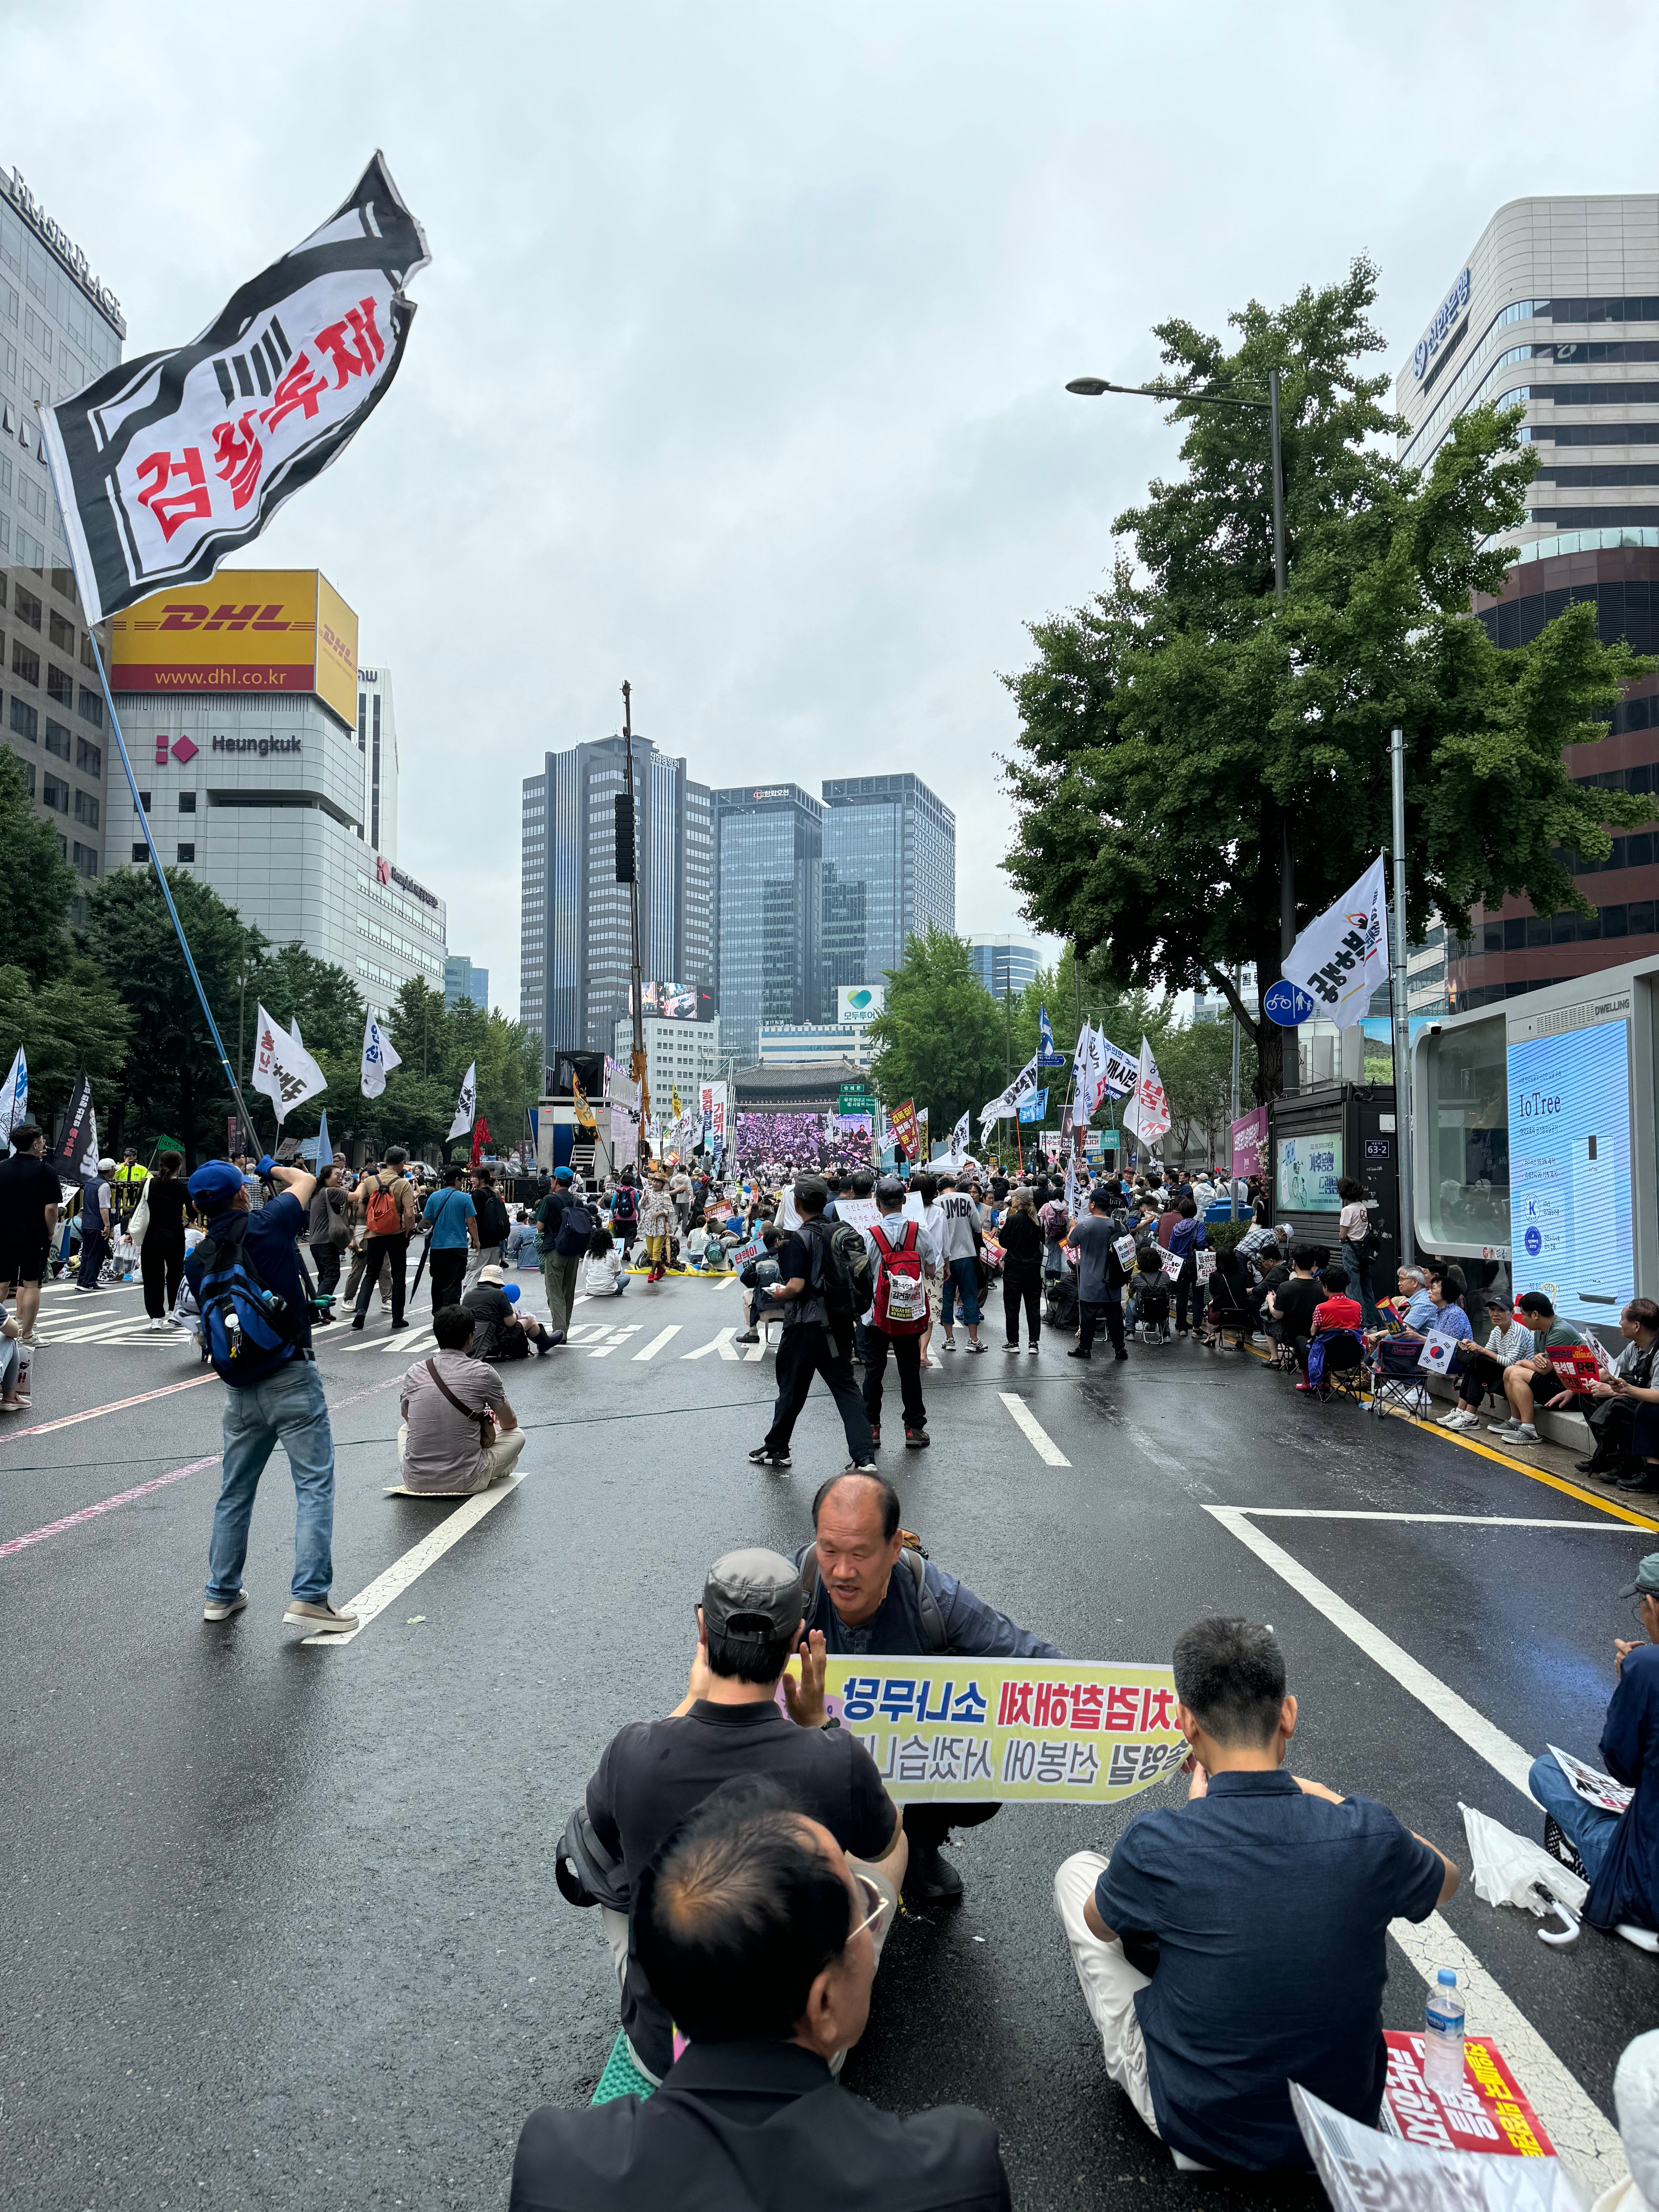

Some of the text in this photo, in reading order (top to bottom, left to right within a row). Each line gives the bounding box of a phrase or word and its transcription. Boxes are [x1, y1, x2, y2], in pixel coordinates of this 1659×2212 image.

[1428, 267, 1470, 356] 신한은행
[158, 605, 292, 631] DHL
[323, 623, 352, 667] DHL
[155, 669, 287, 684] www.dhl.co.kr
[213, 735, 302, 755] Heungkuk
[844, 1011, 875, 1020] 모두투어
[1594, 999, 1630, 1016] DWELLING
[1519, 1092, 1561, 1117] IoTree
[1367, 1146, 1387, 1154] 63-2
[892, 1291, 911, 1300] 김건희
[1553, 1362, 1576, 1375] 윤석열
[1463, 2041, 1515, 2102] 친일매국
